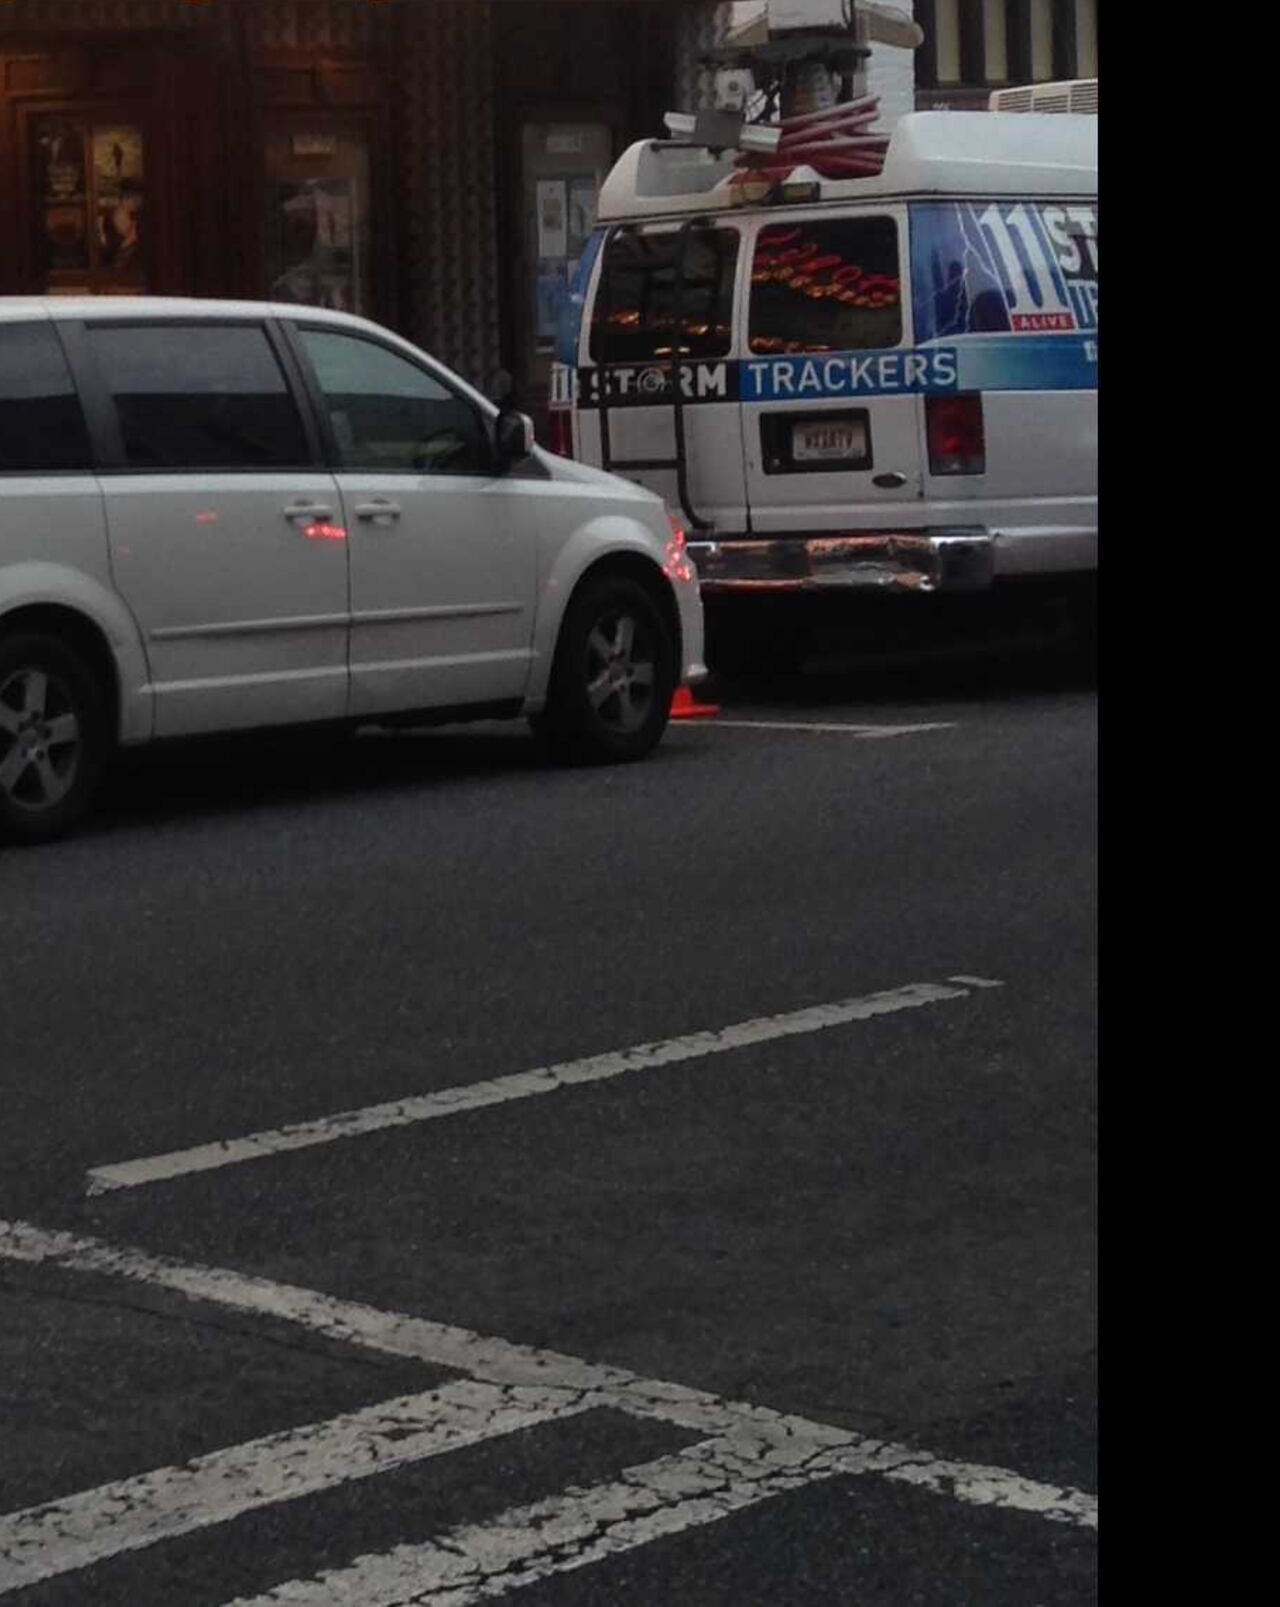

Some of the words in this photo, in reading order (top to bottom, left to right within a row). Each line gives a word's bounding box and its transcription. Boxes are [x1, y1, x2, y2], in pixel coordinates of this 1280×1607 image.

[980, 203, 1069, 310] 11
[1020, 315, 1068, 329] ALIVE
[748, 351, 958, 395] TRACKERS
